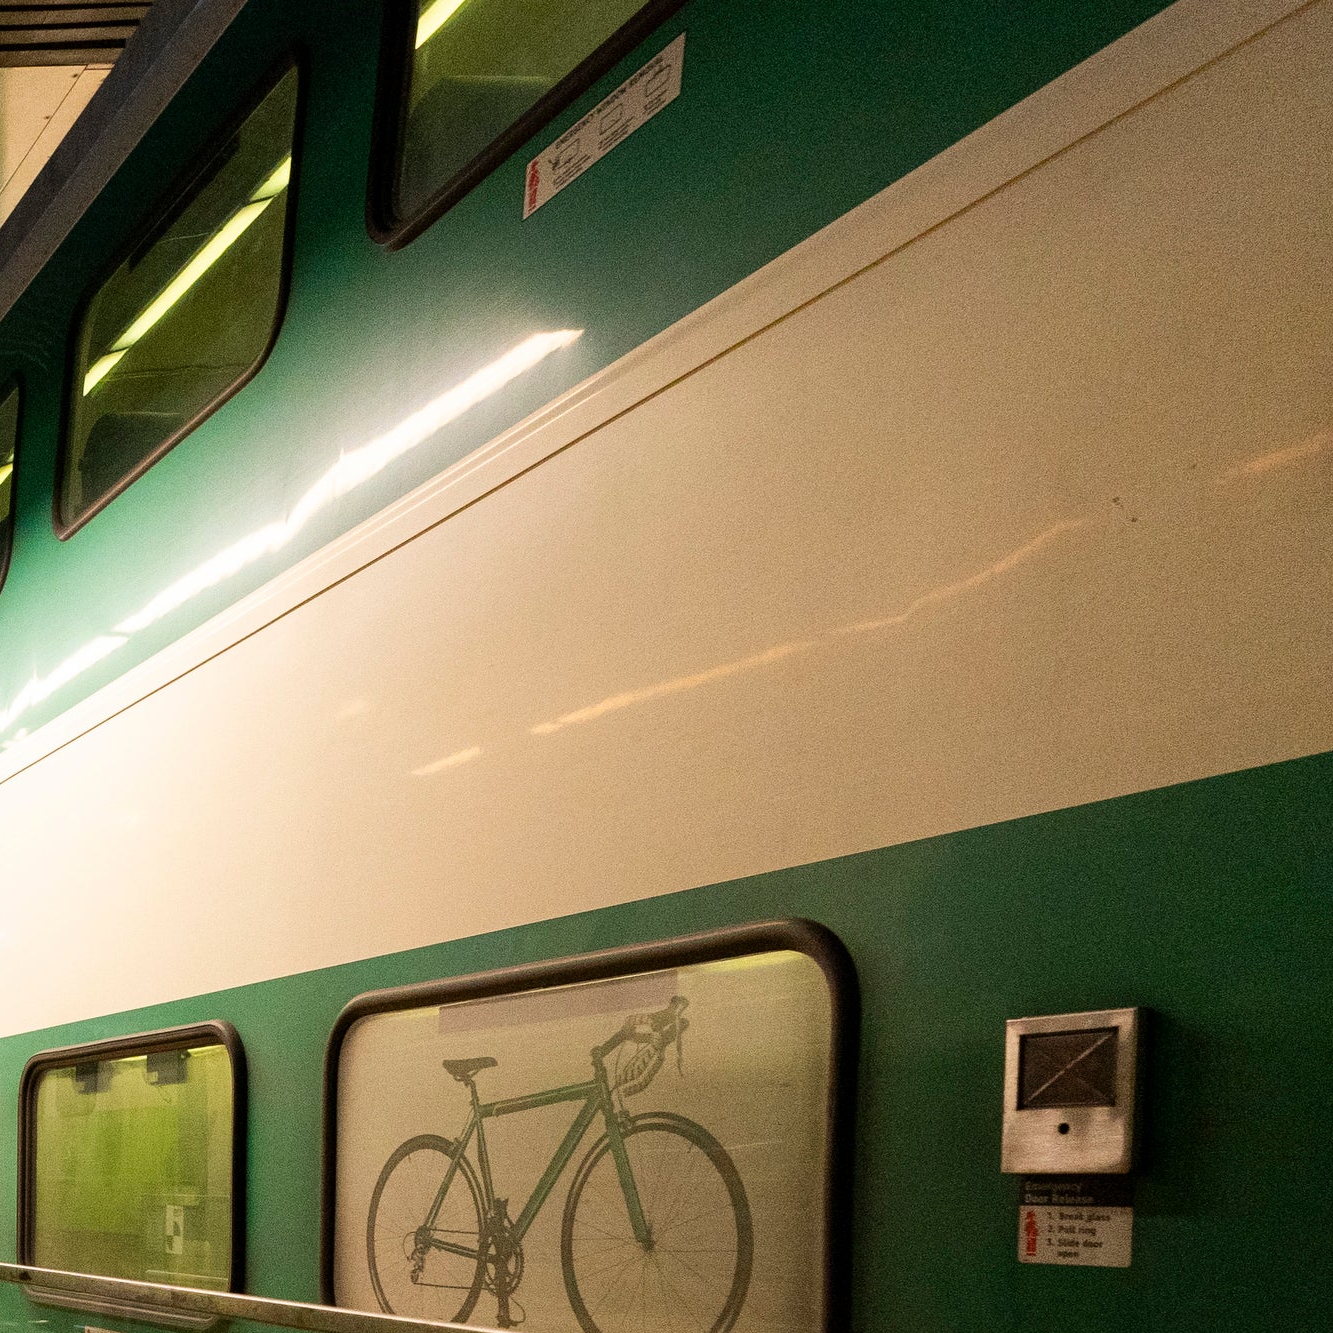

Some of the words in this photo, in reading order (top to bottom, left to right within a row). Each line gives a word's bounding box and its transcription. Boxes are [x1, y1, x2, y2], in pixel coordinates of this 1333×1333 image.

[1025, 1193, 1049, 1204] Door
[1059, 1211, 1083, 1221] Break
[1085, 1212, 1110, 1223] glass
[1058, 1225, 1076, 1234] Pull
[1078, 1227, 1096, 1237] ring
[1057, 1238, 1080, 1248] Slide
[1082, 1239, 1103, 1248] door
